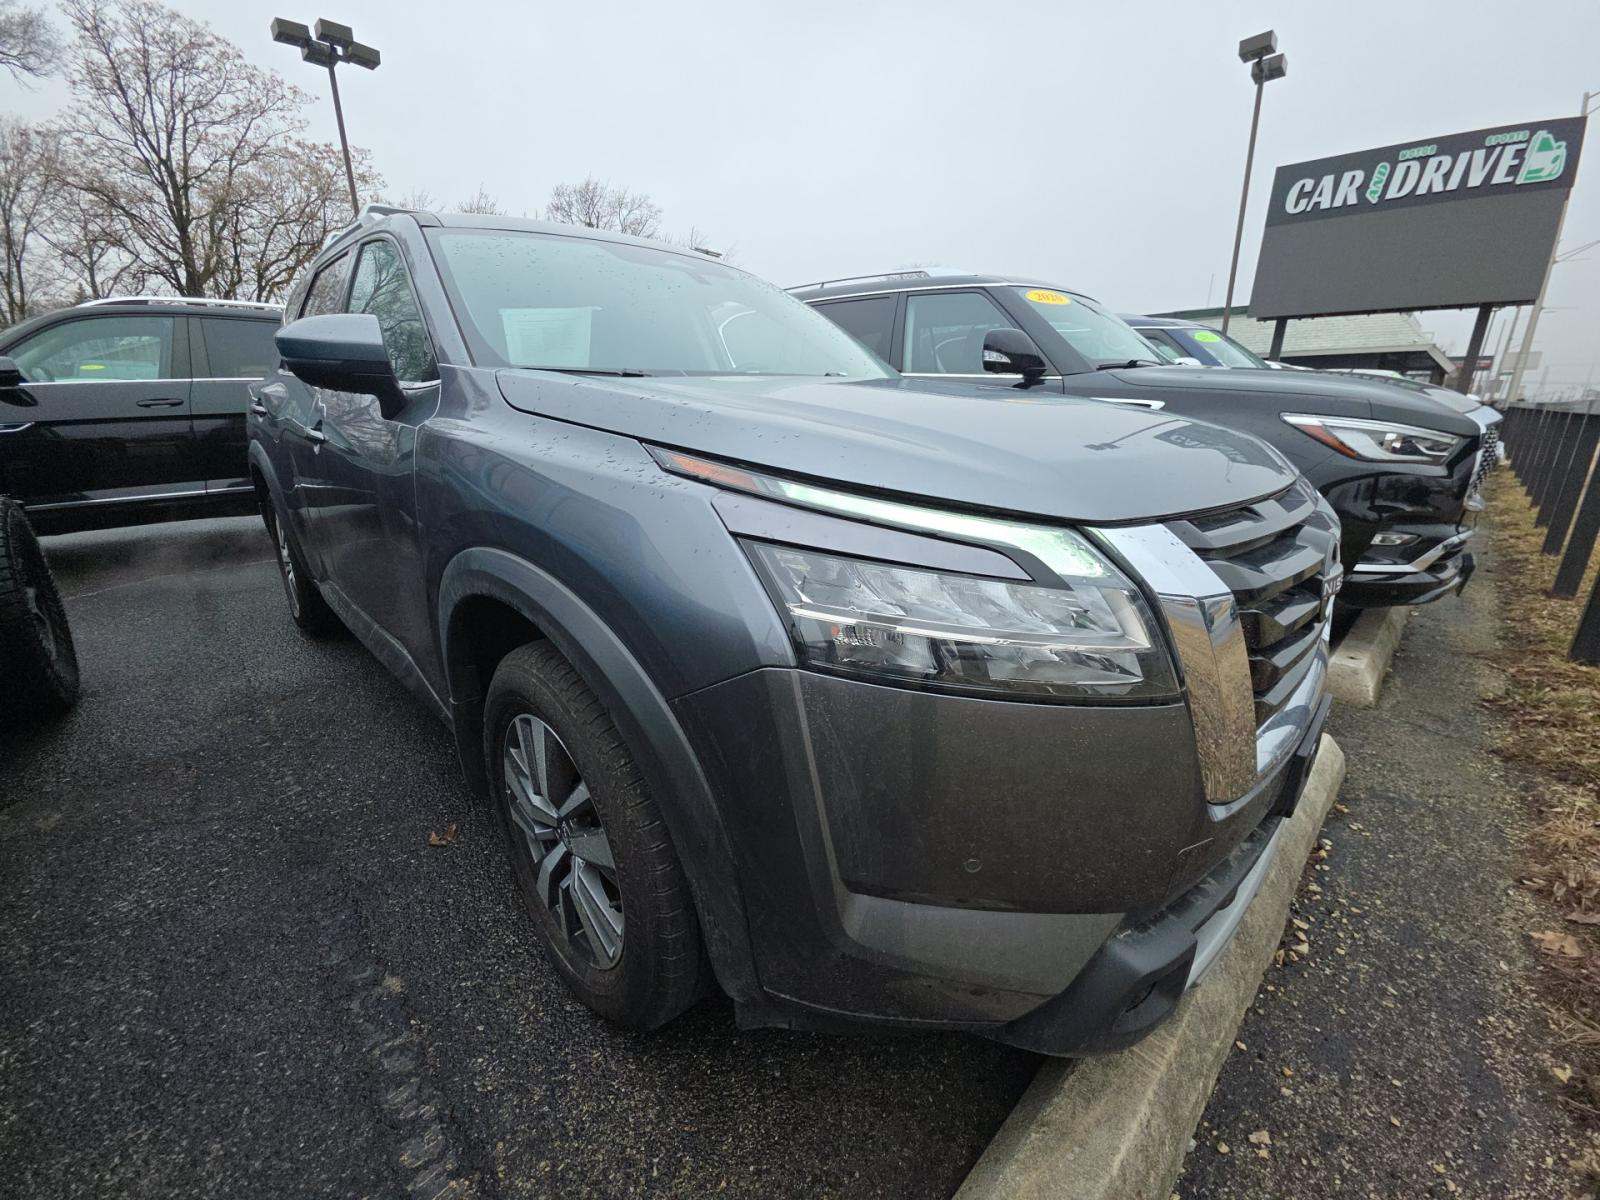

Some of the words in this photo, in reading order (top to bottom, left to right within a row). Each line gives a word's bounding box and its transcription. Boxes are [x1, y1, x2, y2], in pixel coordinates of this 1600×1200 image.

[1285, 169, 1365, 214] CAR
[1365, 162, 1390, 204] AND
[1385, 142, 1527, 200] DRIVE
